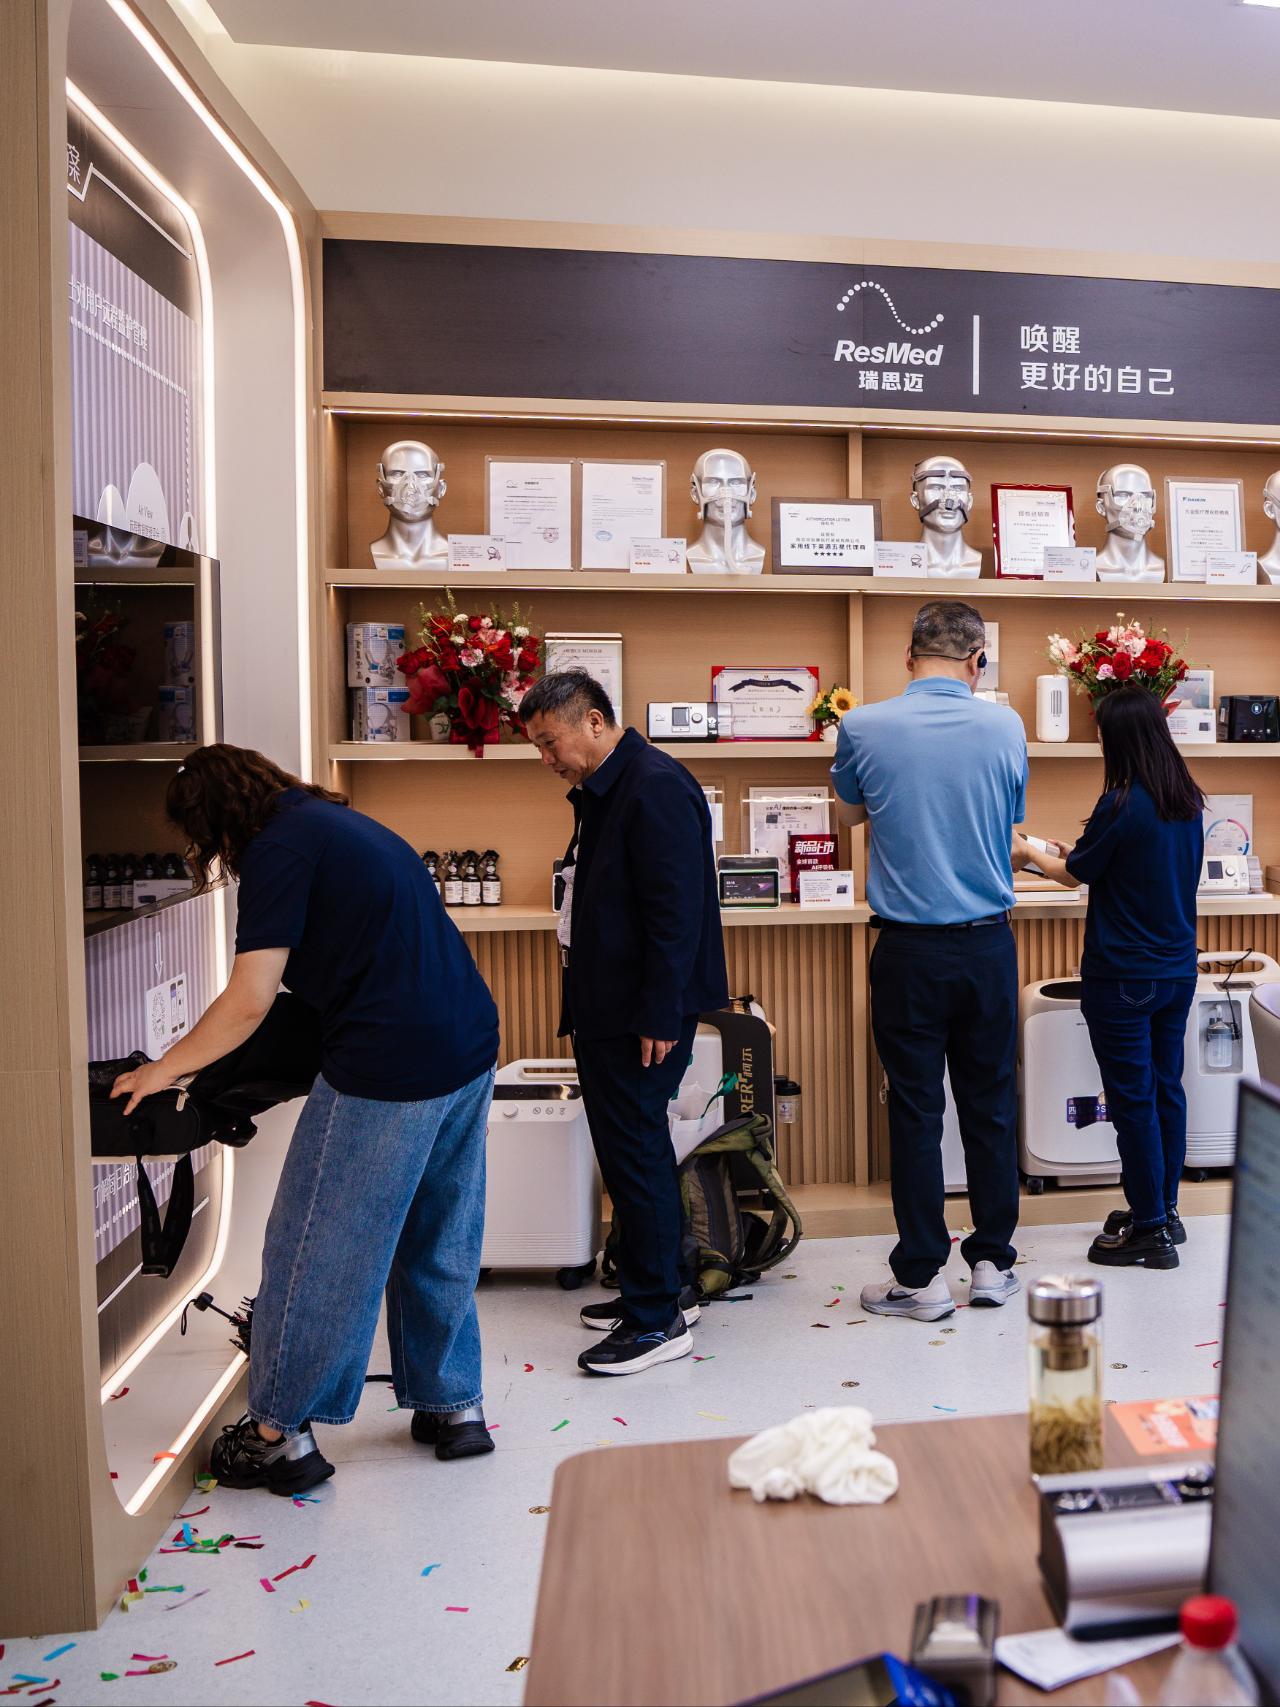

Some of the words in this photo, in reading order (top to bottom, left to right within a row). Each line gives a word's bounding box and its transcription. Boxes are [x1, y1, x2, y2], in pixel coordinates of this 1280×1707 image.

[66, 143, 81, 185] 案
[834, 340, 944, 366] ResMed
[1019, 324, 1081, 355] 唤醒
[858, 370, 925, 393] 瑞思迈
[1019, 361, 1175, 396] 更好的自己
[795, 840, 835, 855] 新品上市
